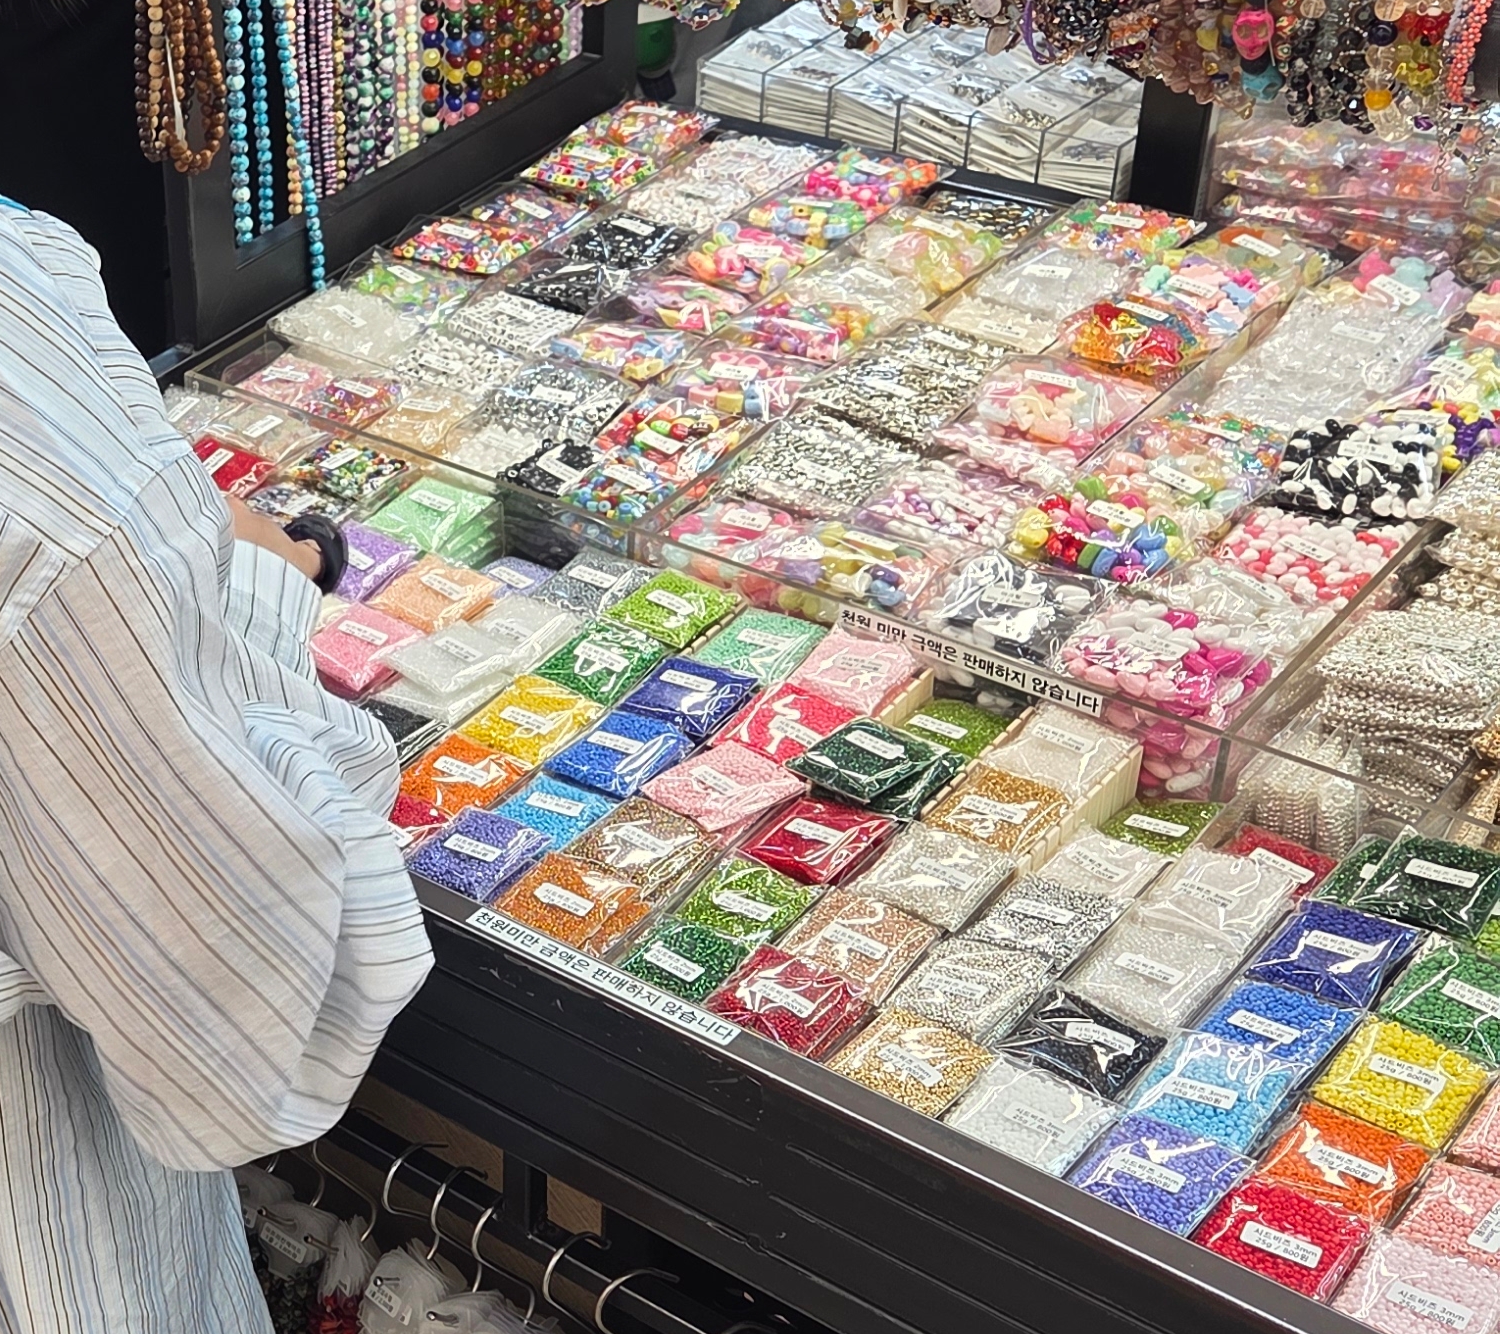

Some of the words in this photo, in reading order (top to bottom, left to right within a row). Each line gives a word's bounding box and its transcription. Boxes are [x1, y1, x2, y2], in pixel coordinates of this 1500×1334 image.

[962, 652, 1026, 688] 판매하지
[1031, 676, 1100, 714] 않습니다
[476, 910, 540, 948] 천원미만
[538, 942, 590, 973] 금액은
[591, 966, 662, 1006] 판매하지
[661, 999, 735, 1041] 않습니다
[1377, 1056, 1414, 1072] 시드비즈
[1317, 1148, 1354, 1165] 시드비즈
[1253, 1227, 1291, 1247] 시드비즈
[1294, 1243, 1318, 1258] 3mm
[1398, 1289, 1438, 1309] 시드비즈
